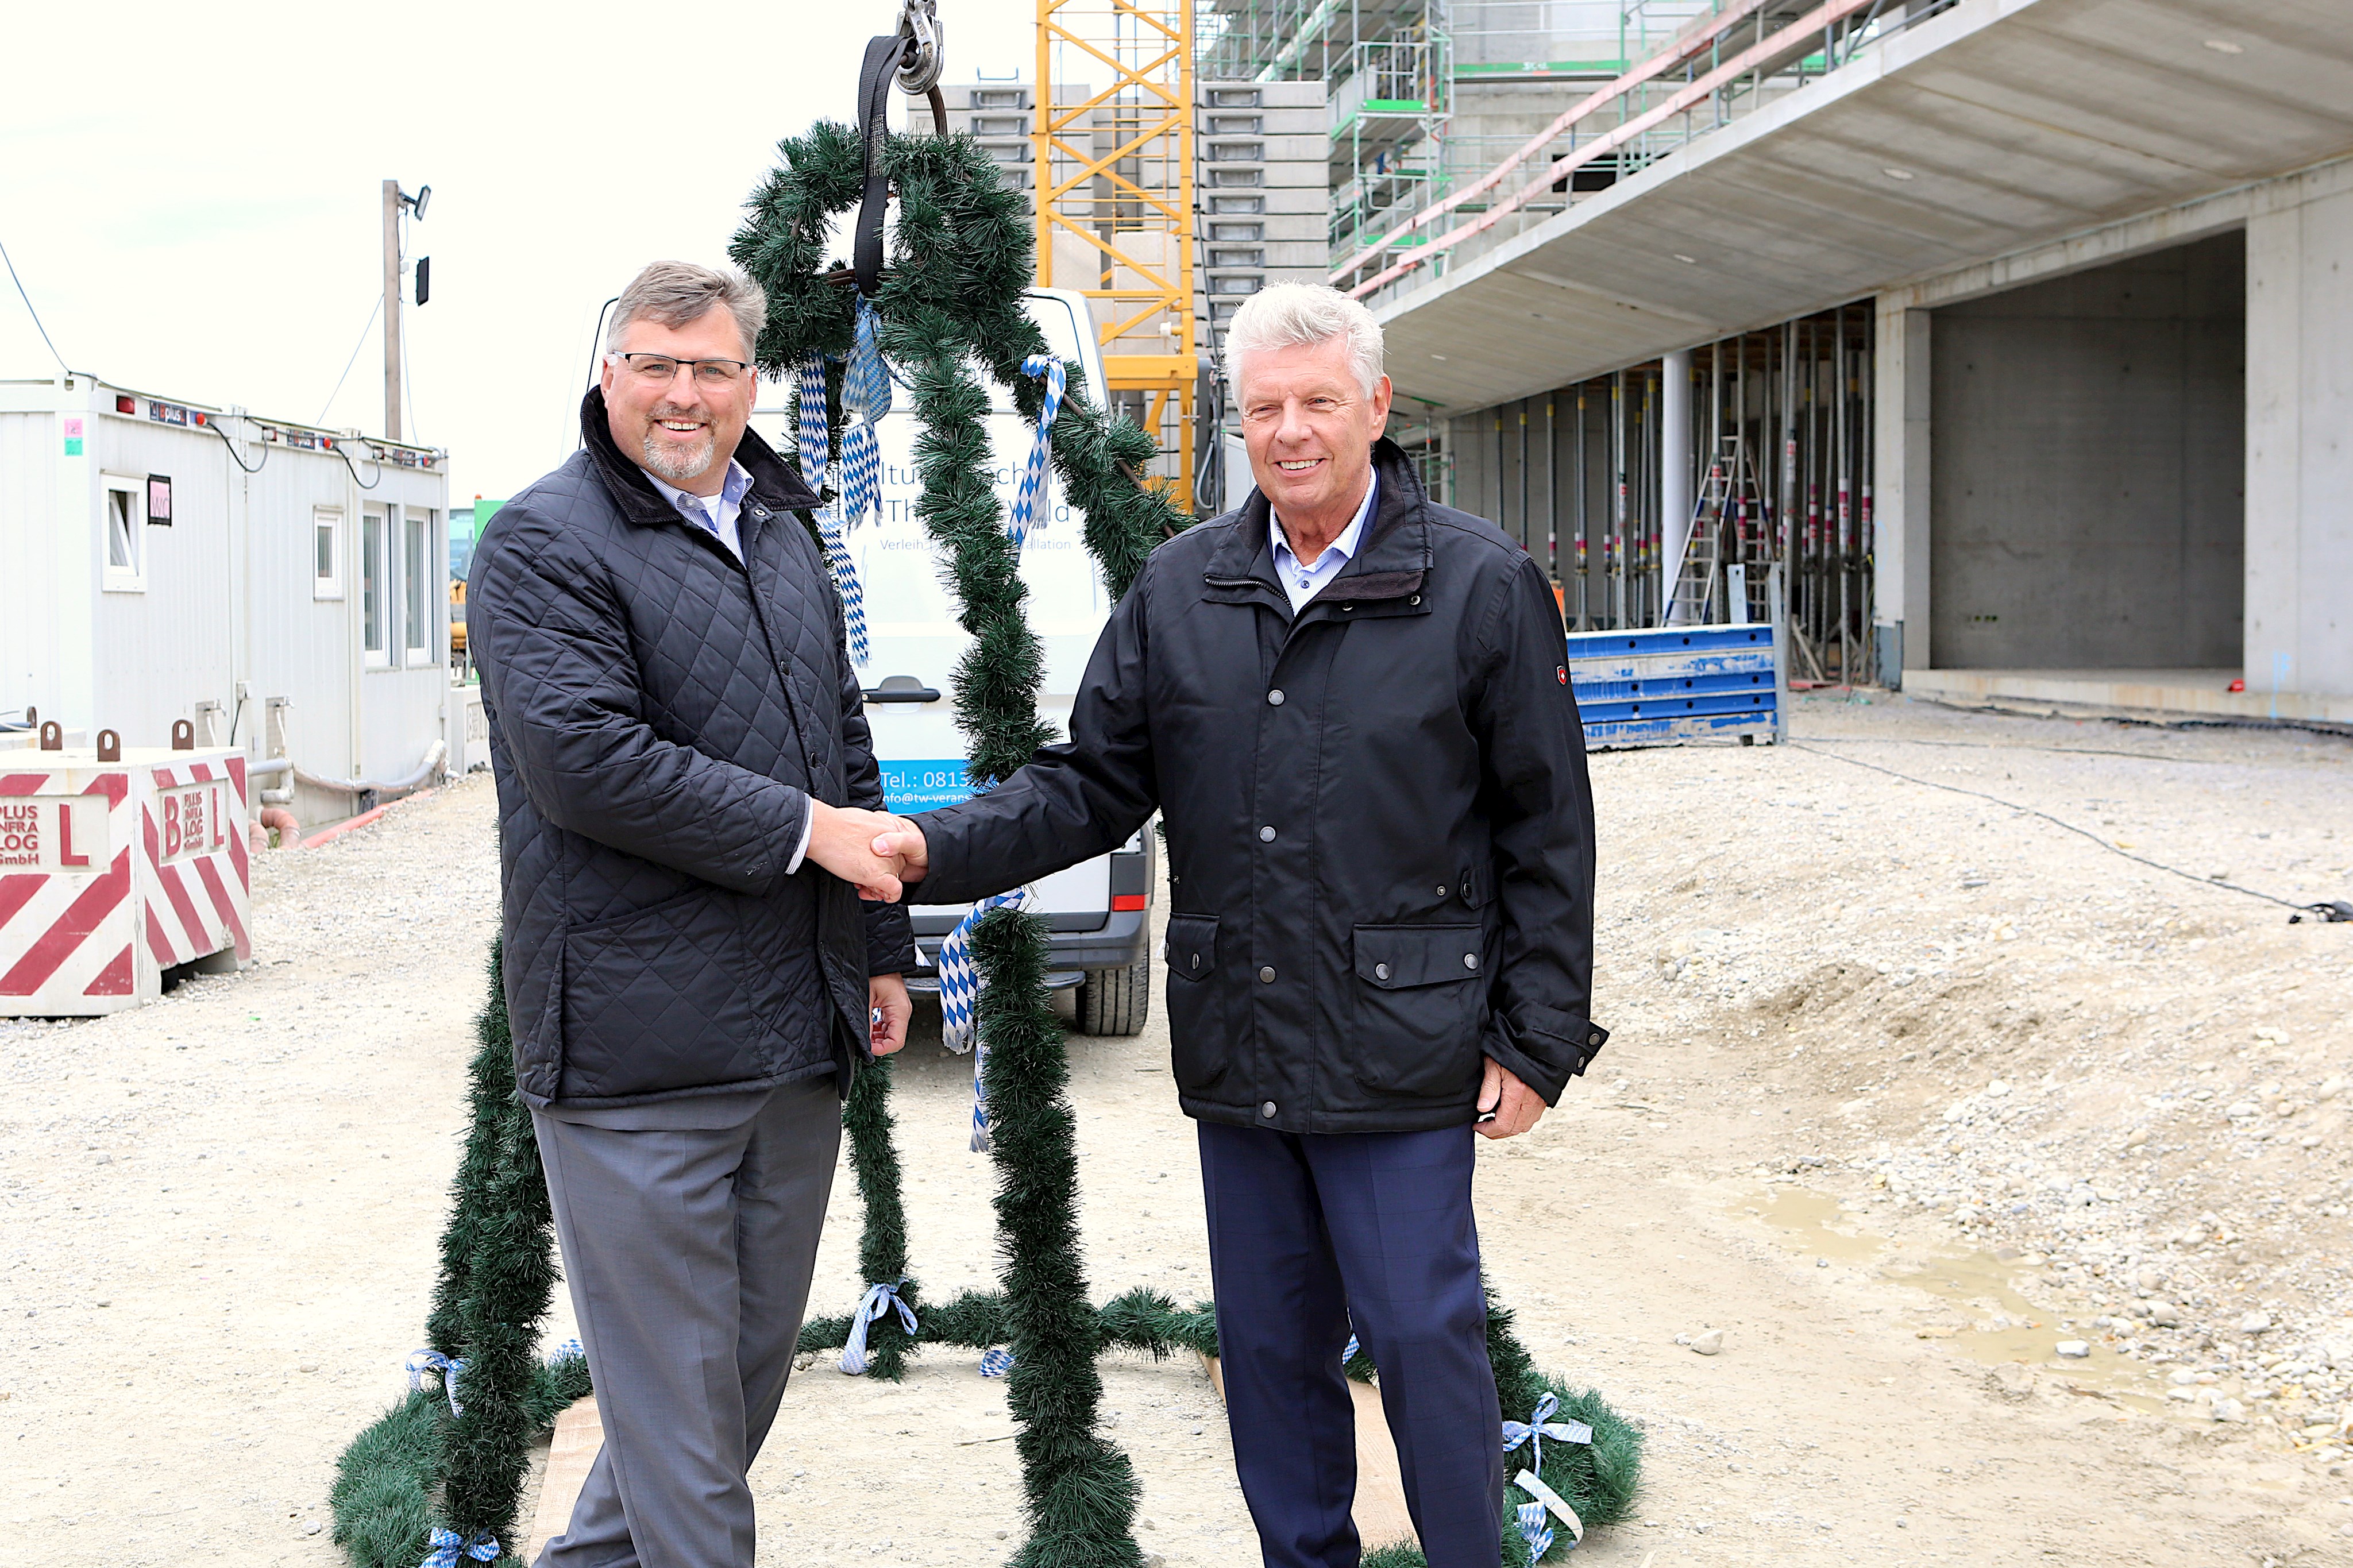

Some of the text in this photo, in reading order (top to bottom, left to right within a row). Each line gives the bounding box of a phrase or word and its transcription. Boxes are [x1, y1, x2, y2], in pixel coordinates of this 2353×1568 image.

[152, 496, 169, 518] WC
[880, 533, 924, 550] Verleih
[880, 771, 967, 788] Tel.: 0813
[184, 791, 202, 806] PLUS
[165, 796, 182, 857] B
[211, 787, 225, 847] L
[59, 804, 89, 866] L
[185, 819, 203, 837] LOG
